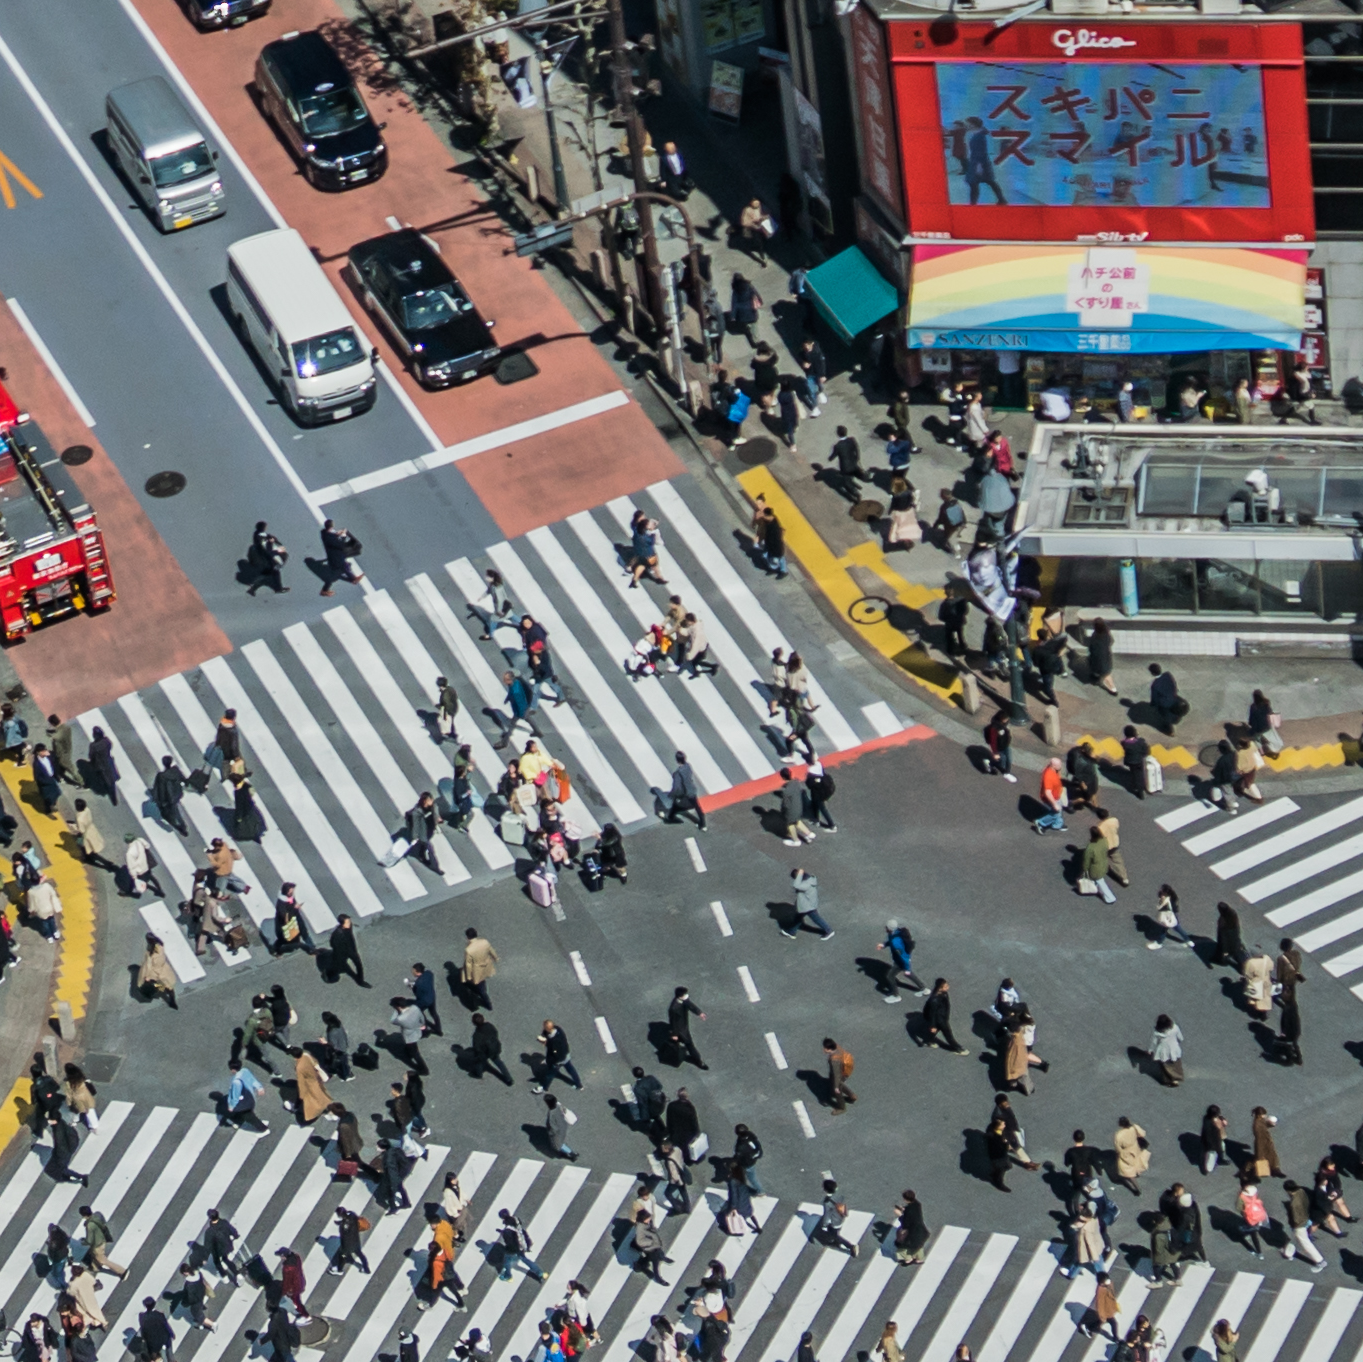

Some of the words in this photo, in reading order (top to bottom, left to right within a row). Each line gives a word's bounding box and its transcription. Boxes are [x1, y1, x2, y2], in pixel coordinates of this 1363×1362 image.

[1052, 29, 1137, 56] Glico
[986, 86, 1211, 121] スキパニ
[991, 129, 1217, 168] スマイル
[1101, 282, 1113, 294] の
[938, 332, 1029, 347] SANZENRI
